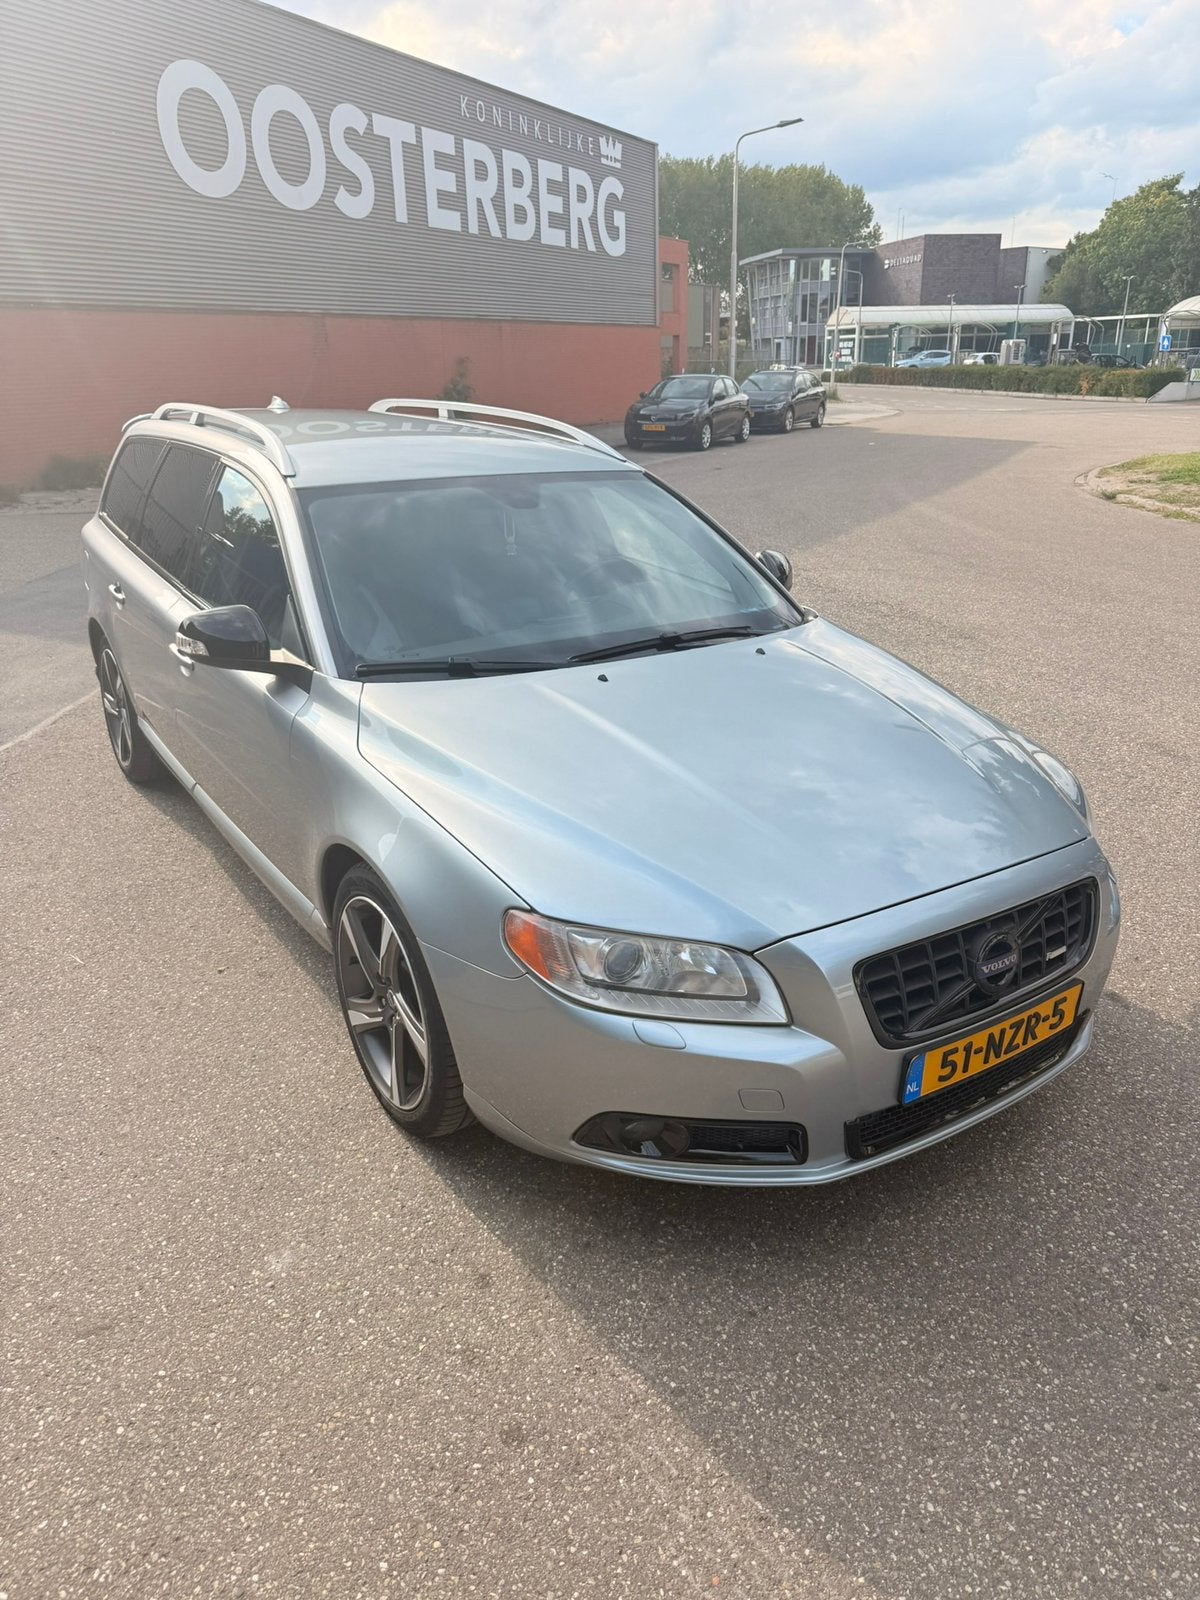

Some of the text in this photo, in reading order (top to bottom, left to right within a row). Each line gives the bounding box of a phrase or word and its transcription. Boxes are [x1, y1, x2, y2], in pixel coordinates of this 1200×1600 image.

[459, 95, 594, 155] KONINKLIJKE
[157, 59, 626, 257] OOSTERBERG
[980, 954, 1017, 974] VOLVO
[938, 996, 1068, 1083] 51-NZR-5
[906, 1081, 919, 1094] NL
